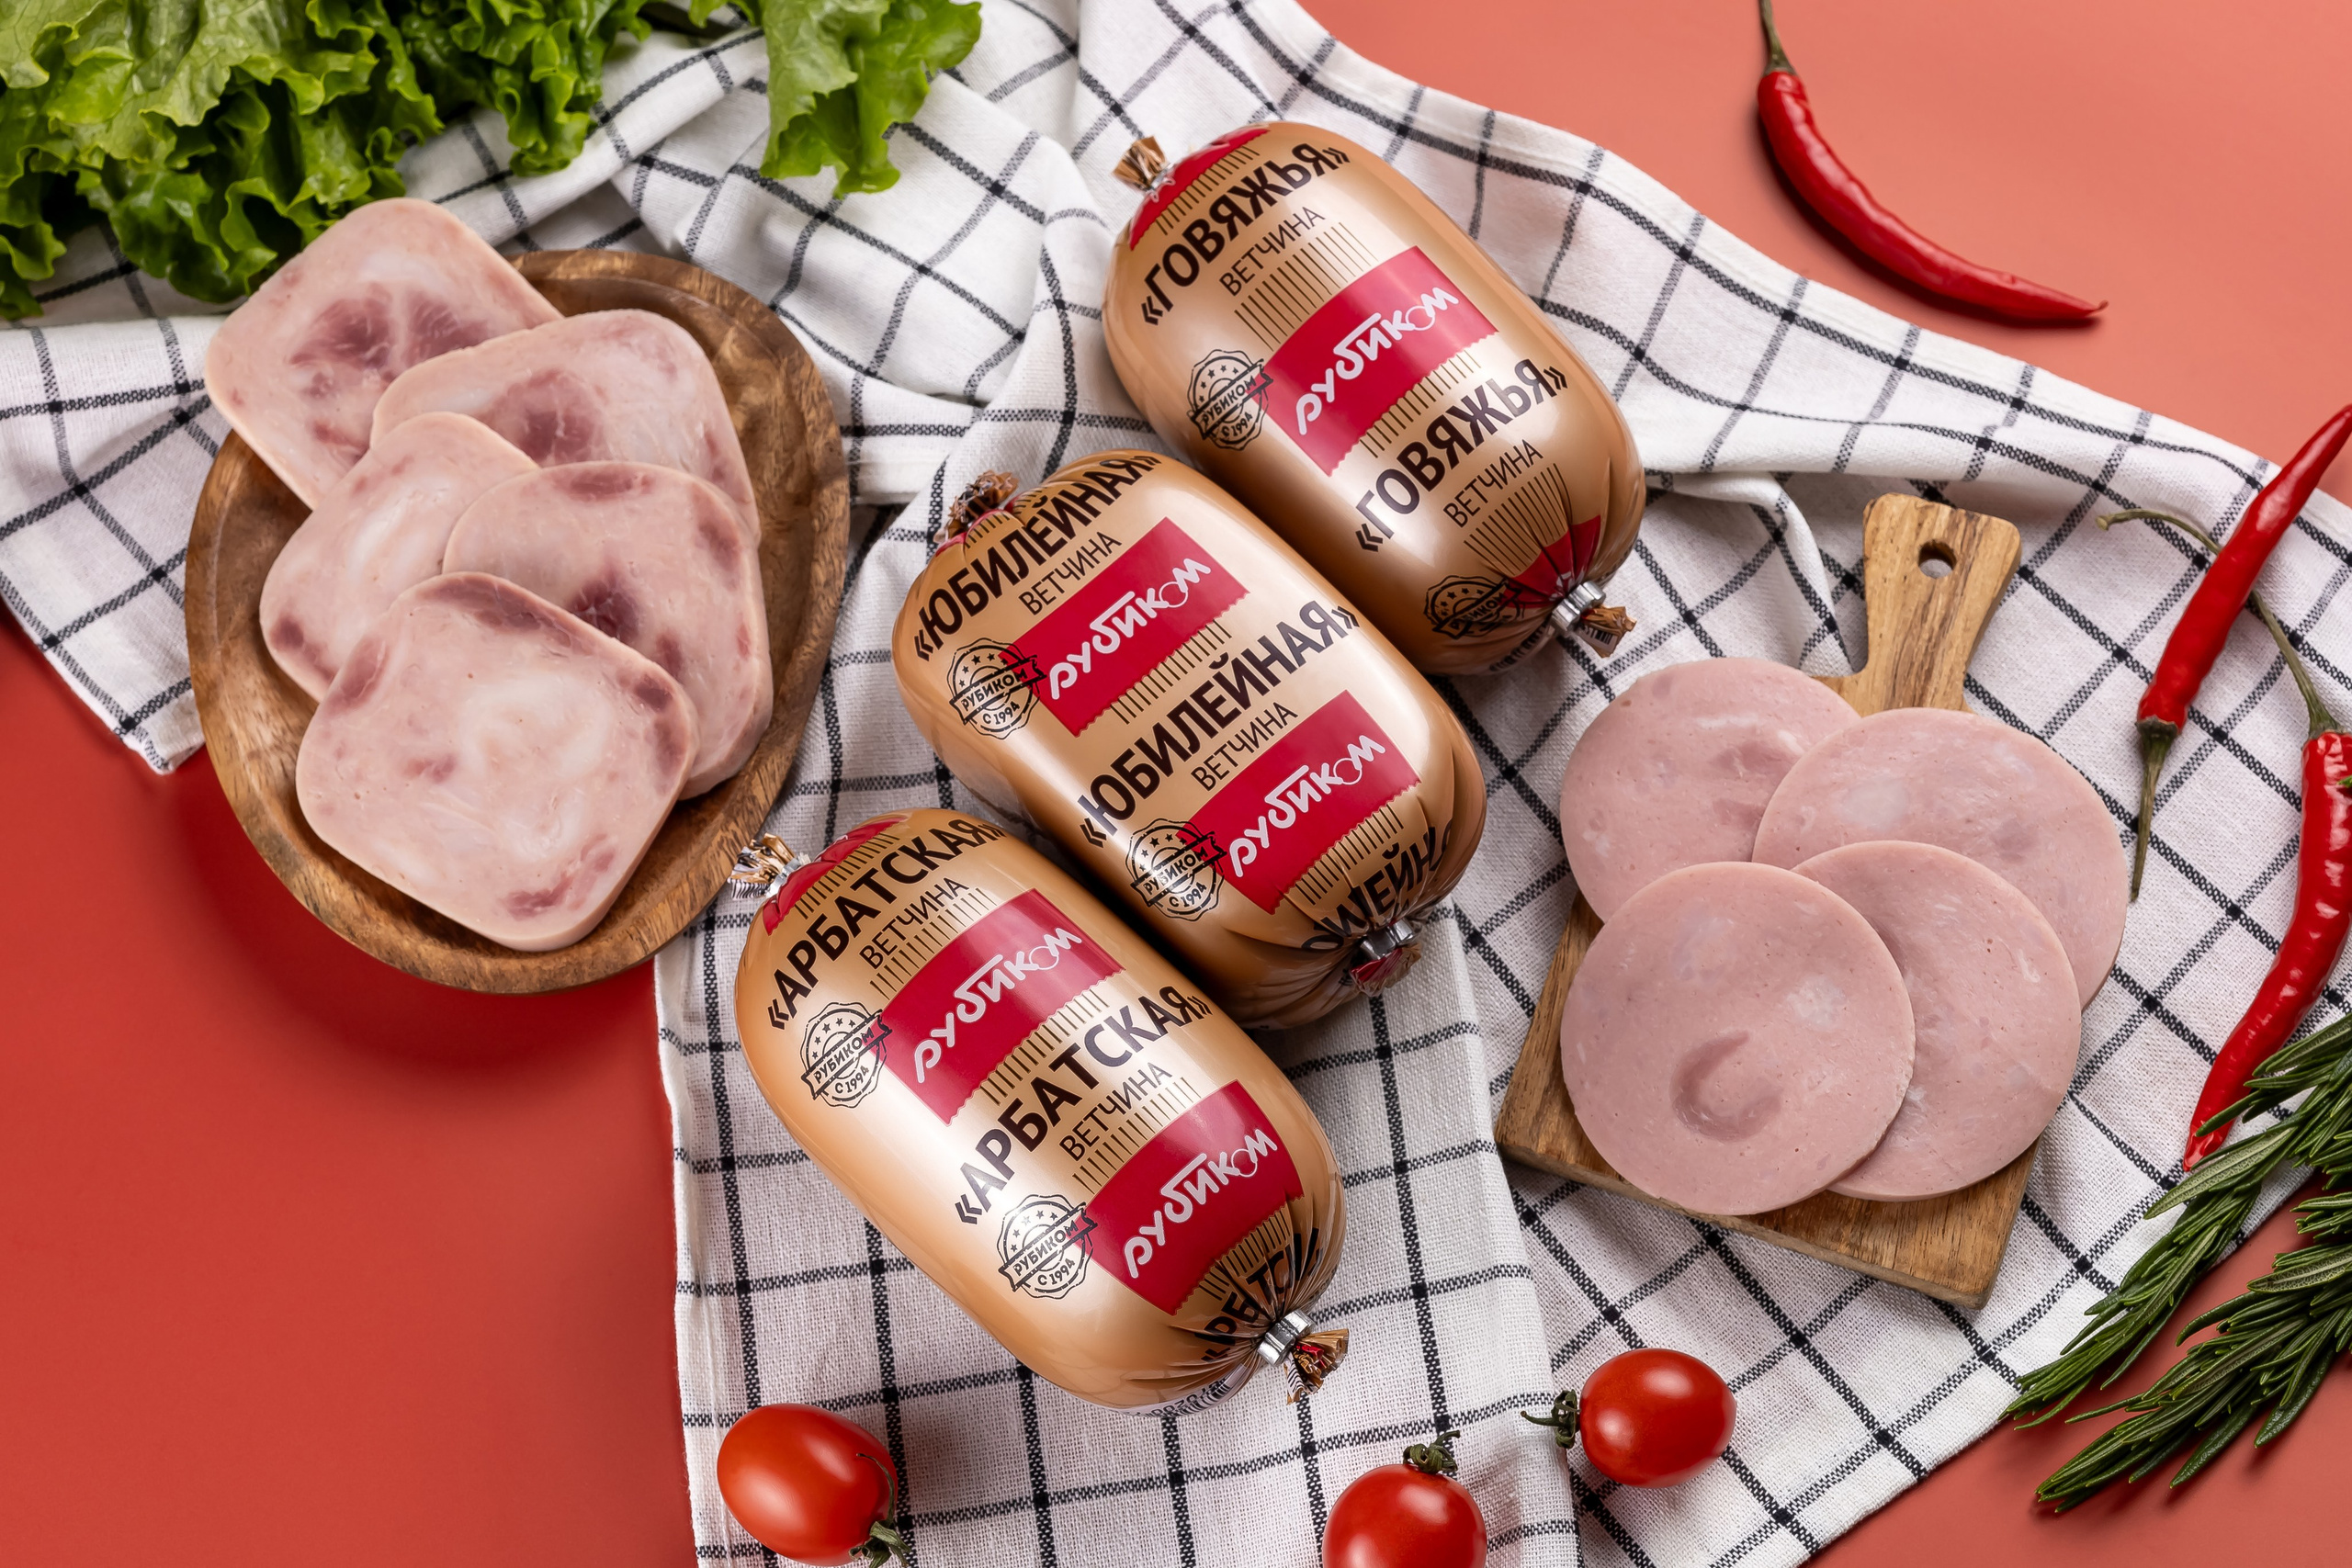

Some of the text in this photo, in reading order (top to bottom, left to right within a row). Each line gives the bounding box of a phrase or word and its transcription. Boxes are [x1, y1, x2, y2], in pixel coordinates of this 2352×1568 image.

[1140, 143, 1351, 326] «ГОВЯЖЬЯ»
[1218, 206, 1326, 297] ВЕТЧИНА
[1201, 375, 1257, 431] РУБИКОМ
[1231, 412, 1253, 436] 1994
[1355, 358, 1568, 552] «ГОВЯЖЬЯ»
[1442, 438, 1544, 528] ВЕТЧИНА
[1018, 530, 1123, 615] ВЕТЧИНА
[960, 668, 1028, 712] РУБИКОМ
[982, 701, 1021, 725] С 1994
[1078, 600, 1360, 848] «ЮБИЛЕЙНАЯ»
[1191, 701, 1298, 792] ВЕТЧИНА
[1143, 846, 1209, 896] РУБИКОМ
[1168, 882, 1207, 908] С 1994
[767, 818, 1008, 1030] «АРБАТСКАЯ»
[858, 877, 970, 970] ВЕТЧИНА
[813, 1026, 875, 1085] РУБИКОМ
[834, 1066, 870, 1094] С 1994
[954, 985, 1214, 1226] «АРБАТСКАЯ»
[1059, 1062, 1173, 1162] ВЕТЧИНА
[1012, 1220, 1080, 1277] РУБИКОМ
[1037, 1258, 1076, 1286] С 1994
